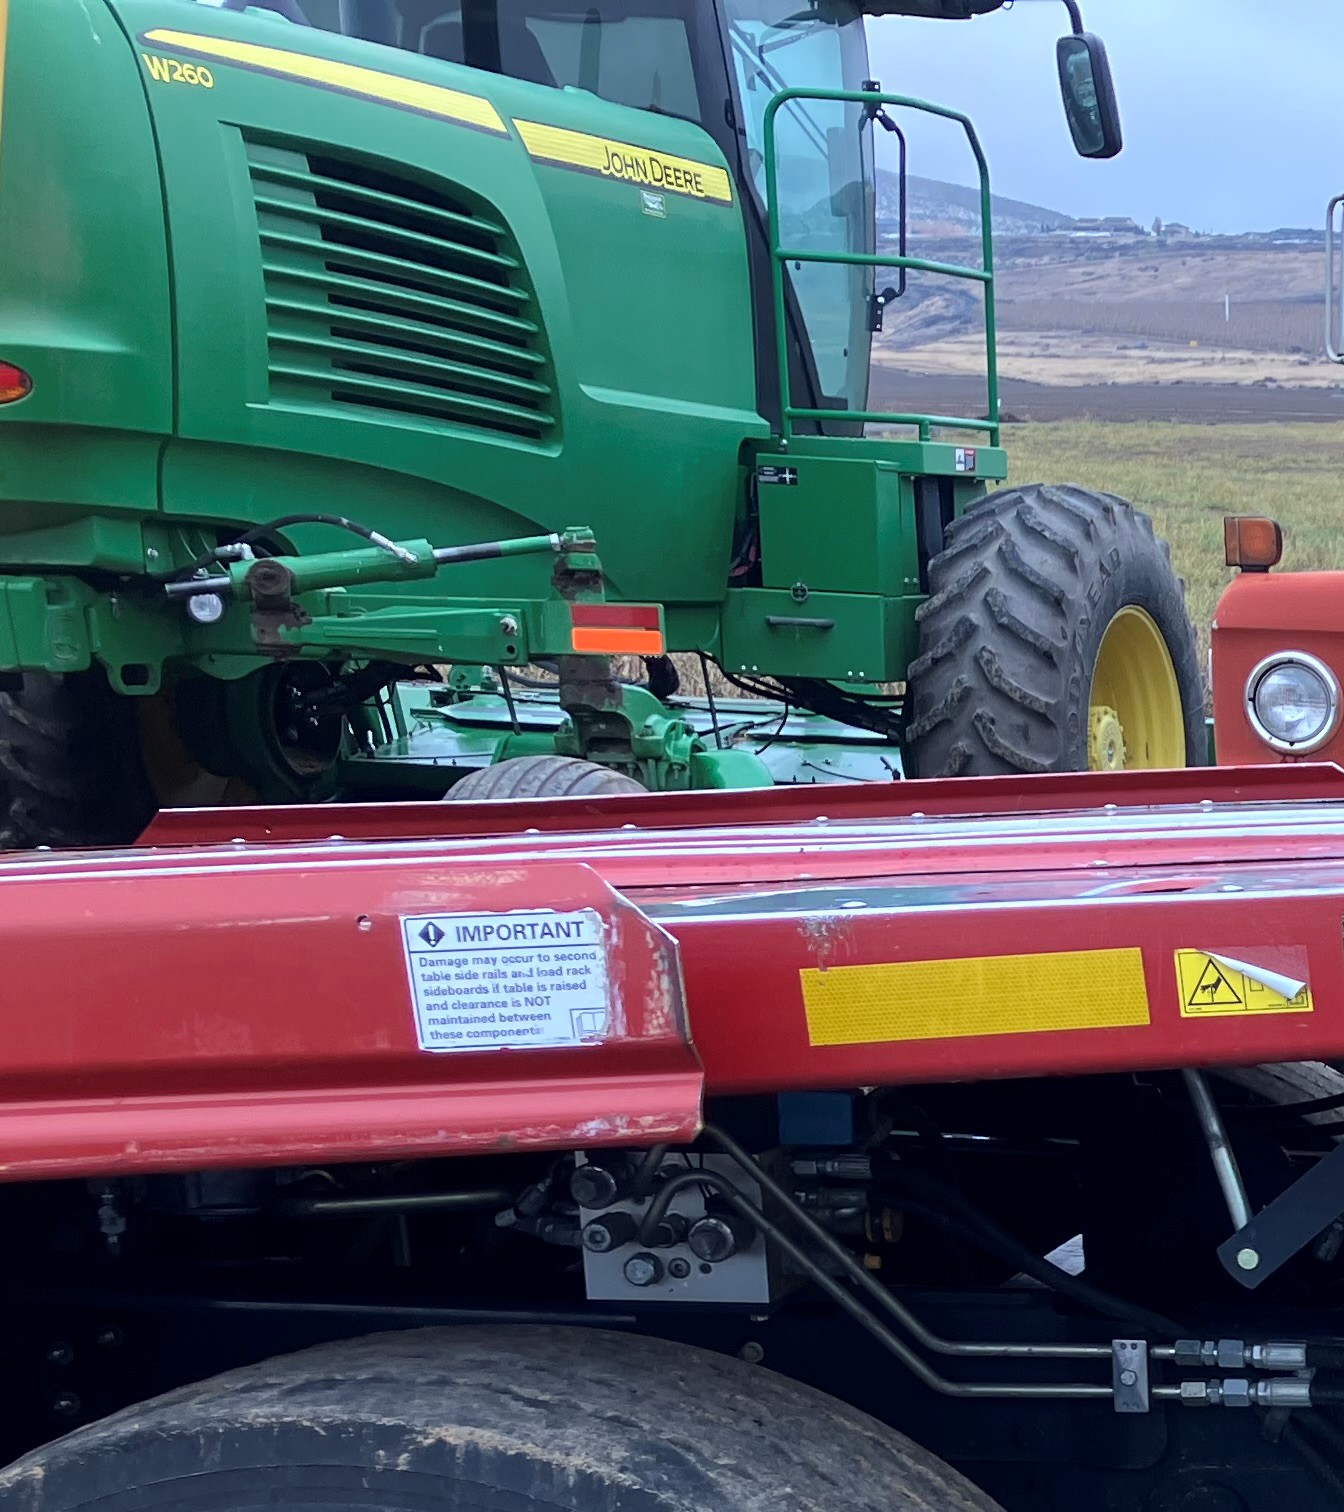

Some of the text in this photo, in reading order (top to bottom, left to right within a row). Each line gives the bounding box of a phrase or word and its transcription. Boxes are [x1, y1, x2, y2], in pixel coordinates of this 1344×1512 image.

[141, 53, 214, 88] W260
[602, 145, 705, 193] JOHN DEERE
[455, 920, 584, 943] IMPORTANT
[419, 950, 597, 968] Damage may occur to second
[421, 970, 451, 981] table
[454, 969, 479, 980] side
[482, 968, 508, 979] rails
[536, 966, 563, 977] load
[566, 964, 592, 976] rack
[423, 979, 587, 997] sideboards if table is raised
[426, 995, 552, 1011] and clearance is NOT
[428, 1012, 552, 1026] maintained between
[430, 1029, 463, 1040] these
